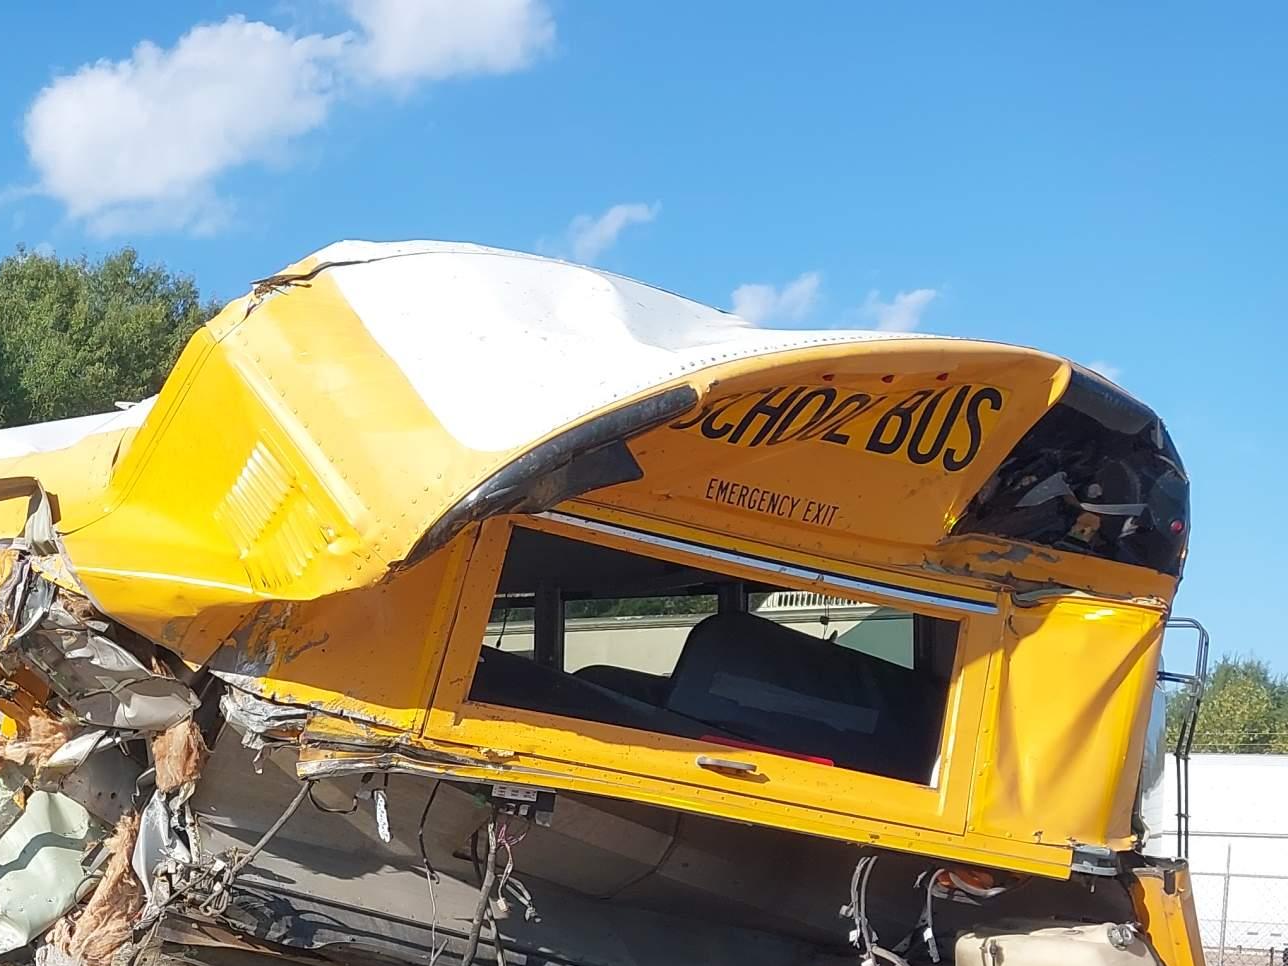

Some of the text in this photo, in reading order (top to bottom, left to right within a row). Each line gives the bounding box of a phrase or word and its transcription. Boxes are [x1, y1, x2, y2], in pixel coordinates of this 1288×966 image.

[865, 384, 1002, 472] BUS
[706, 478, 840, 527] EMERGENCY EXIT
